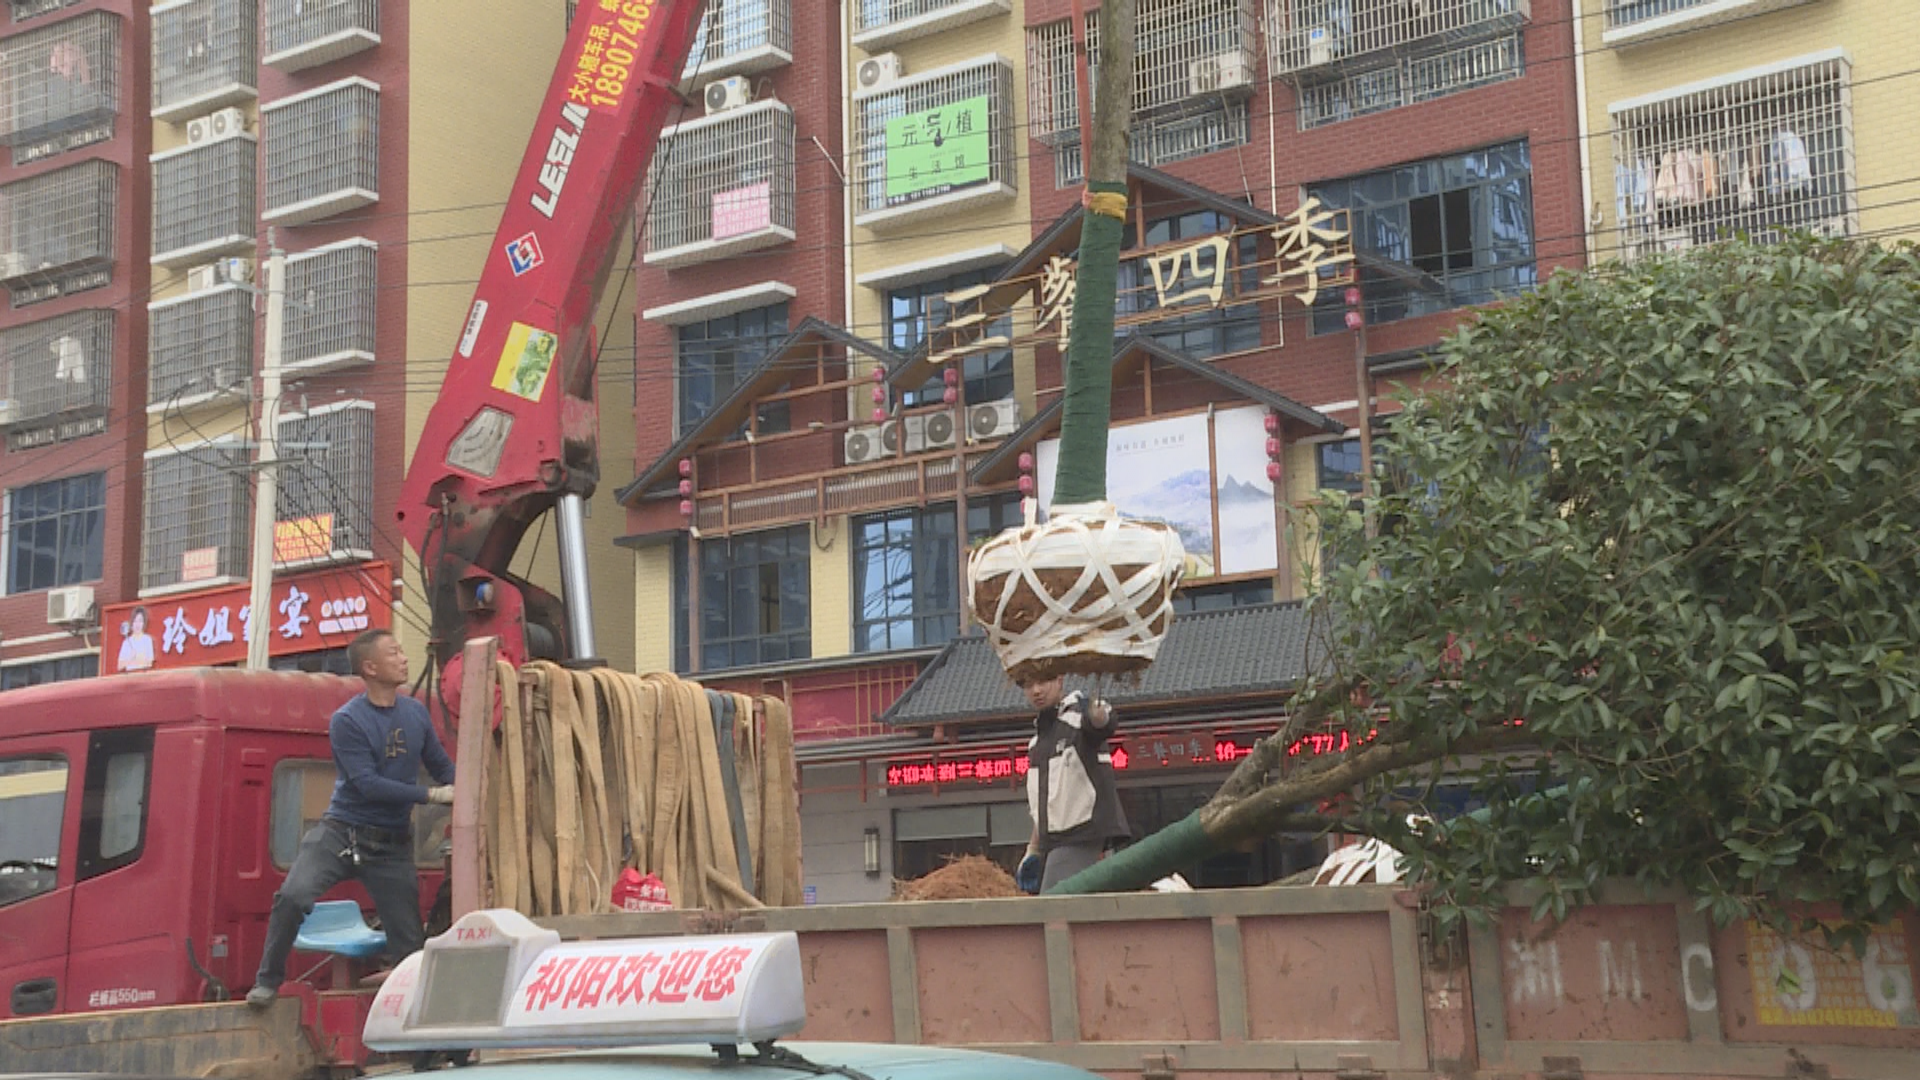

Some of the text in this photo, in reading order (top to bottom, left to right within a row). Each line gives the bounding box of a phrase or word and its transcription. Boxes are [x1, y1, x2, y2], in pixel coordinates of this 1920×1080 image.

[590, 0, 654, 107] 1890746
[457, 927, 494, 941] TAXI
[525, 947, 752, 1011] 祁阳欢迎您
